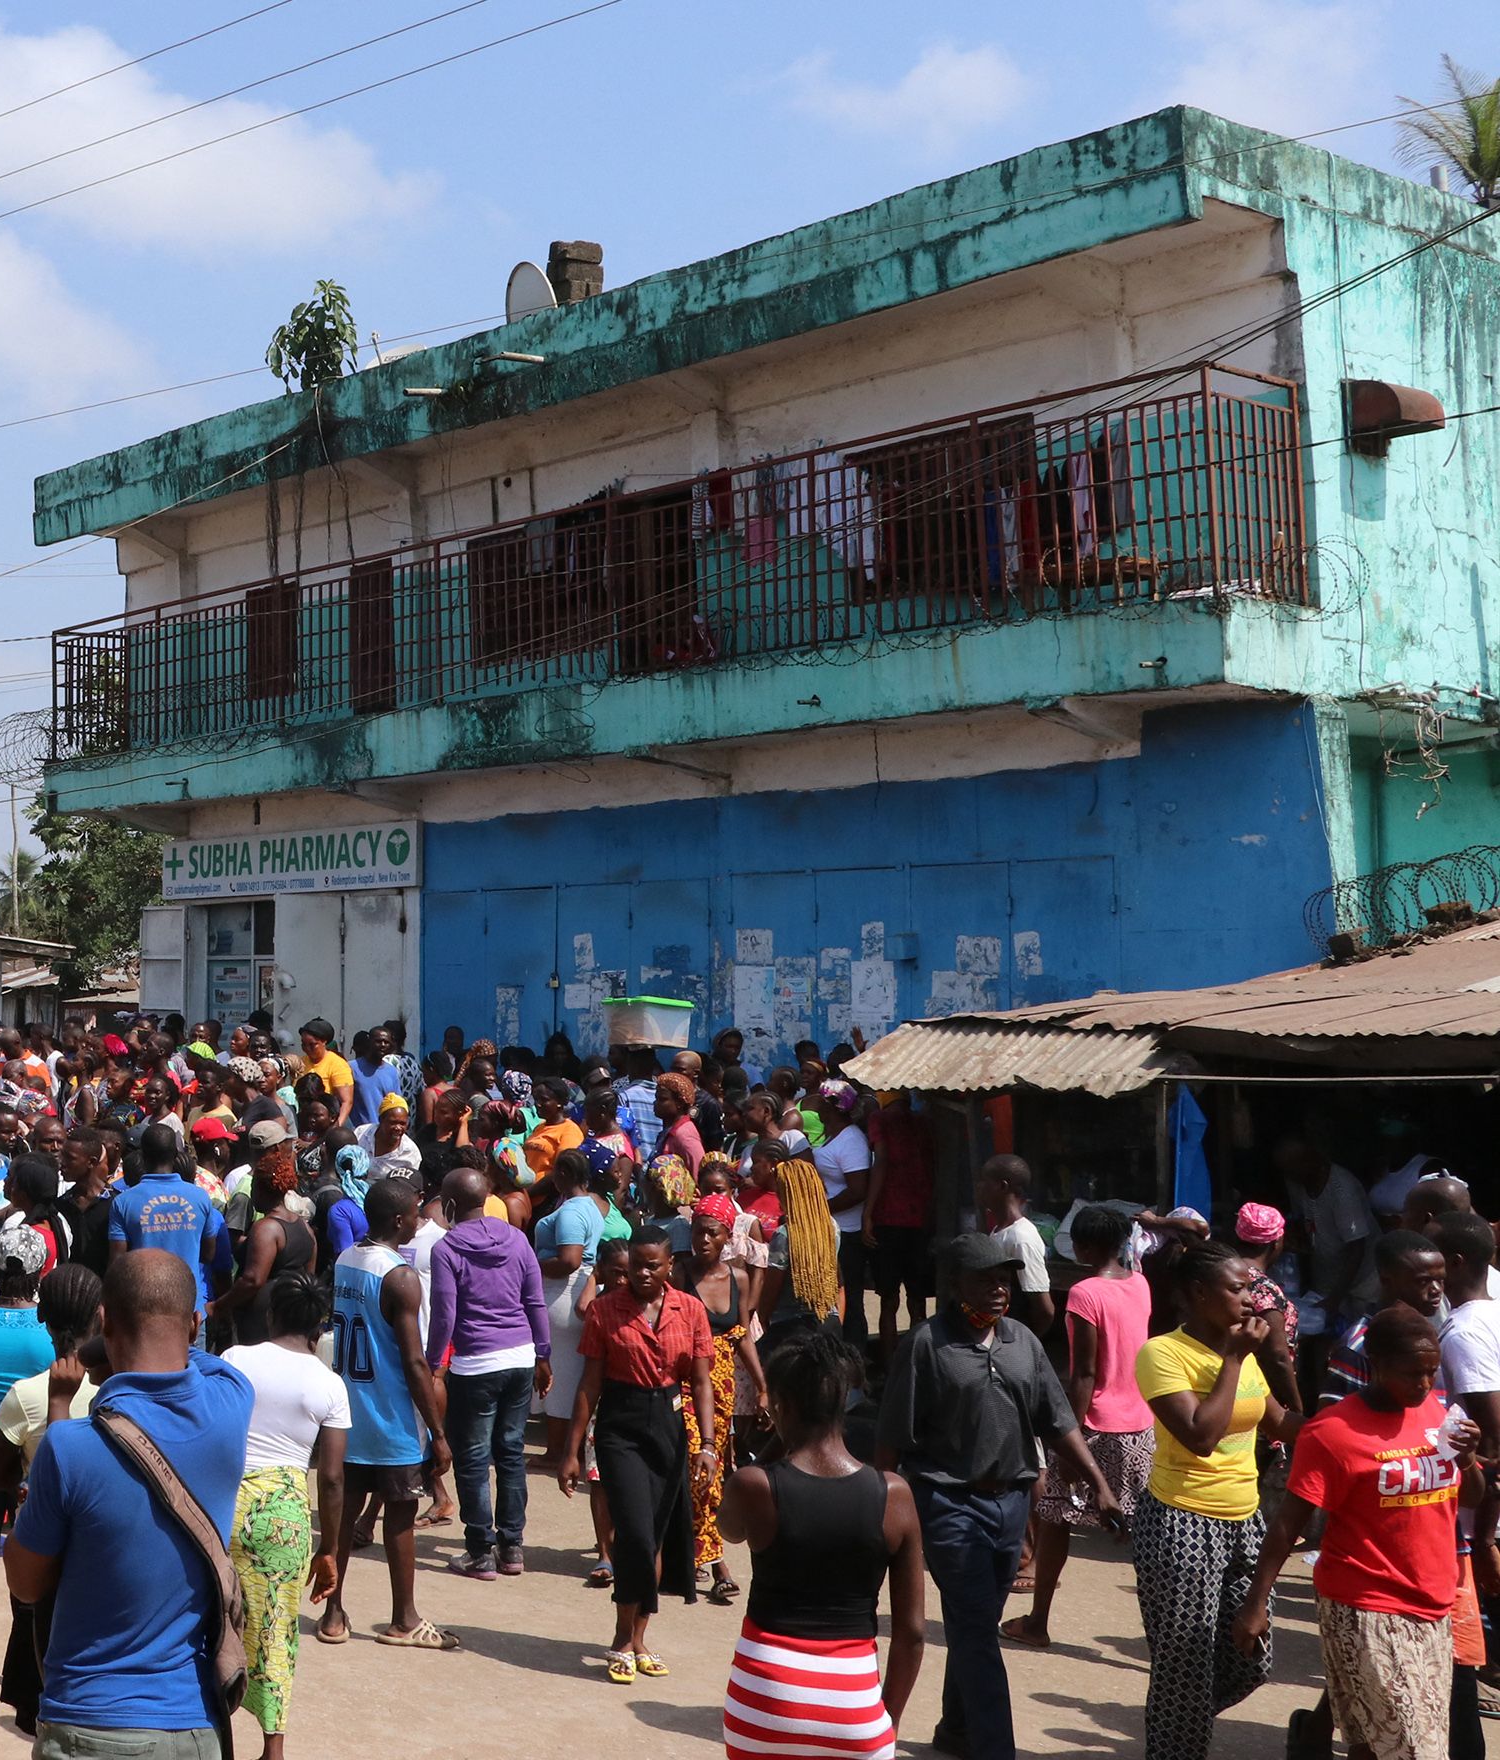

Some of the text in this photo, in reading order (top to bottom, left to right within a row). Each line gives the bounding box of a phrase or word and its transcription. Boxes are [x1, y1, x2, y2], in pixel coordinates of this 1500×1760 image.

[188, 830, 382, 880] SUBHA PHARMACY
[389, 1167, 414, 1180] CR7
[140, 1194, 197, 1225] MONROVIA
[153, 1212, 185, 1225] DAY
[141, 1223, 182, 1234] FEBRUARY
[1374, 1445, 1432, 1463] KANSAS CITY
[1382, 1489, 1458, 1507] FOOTB
